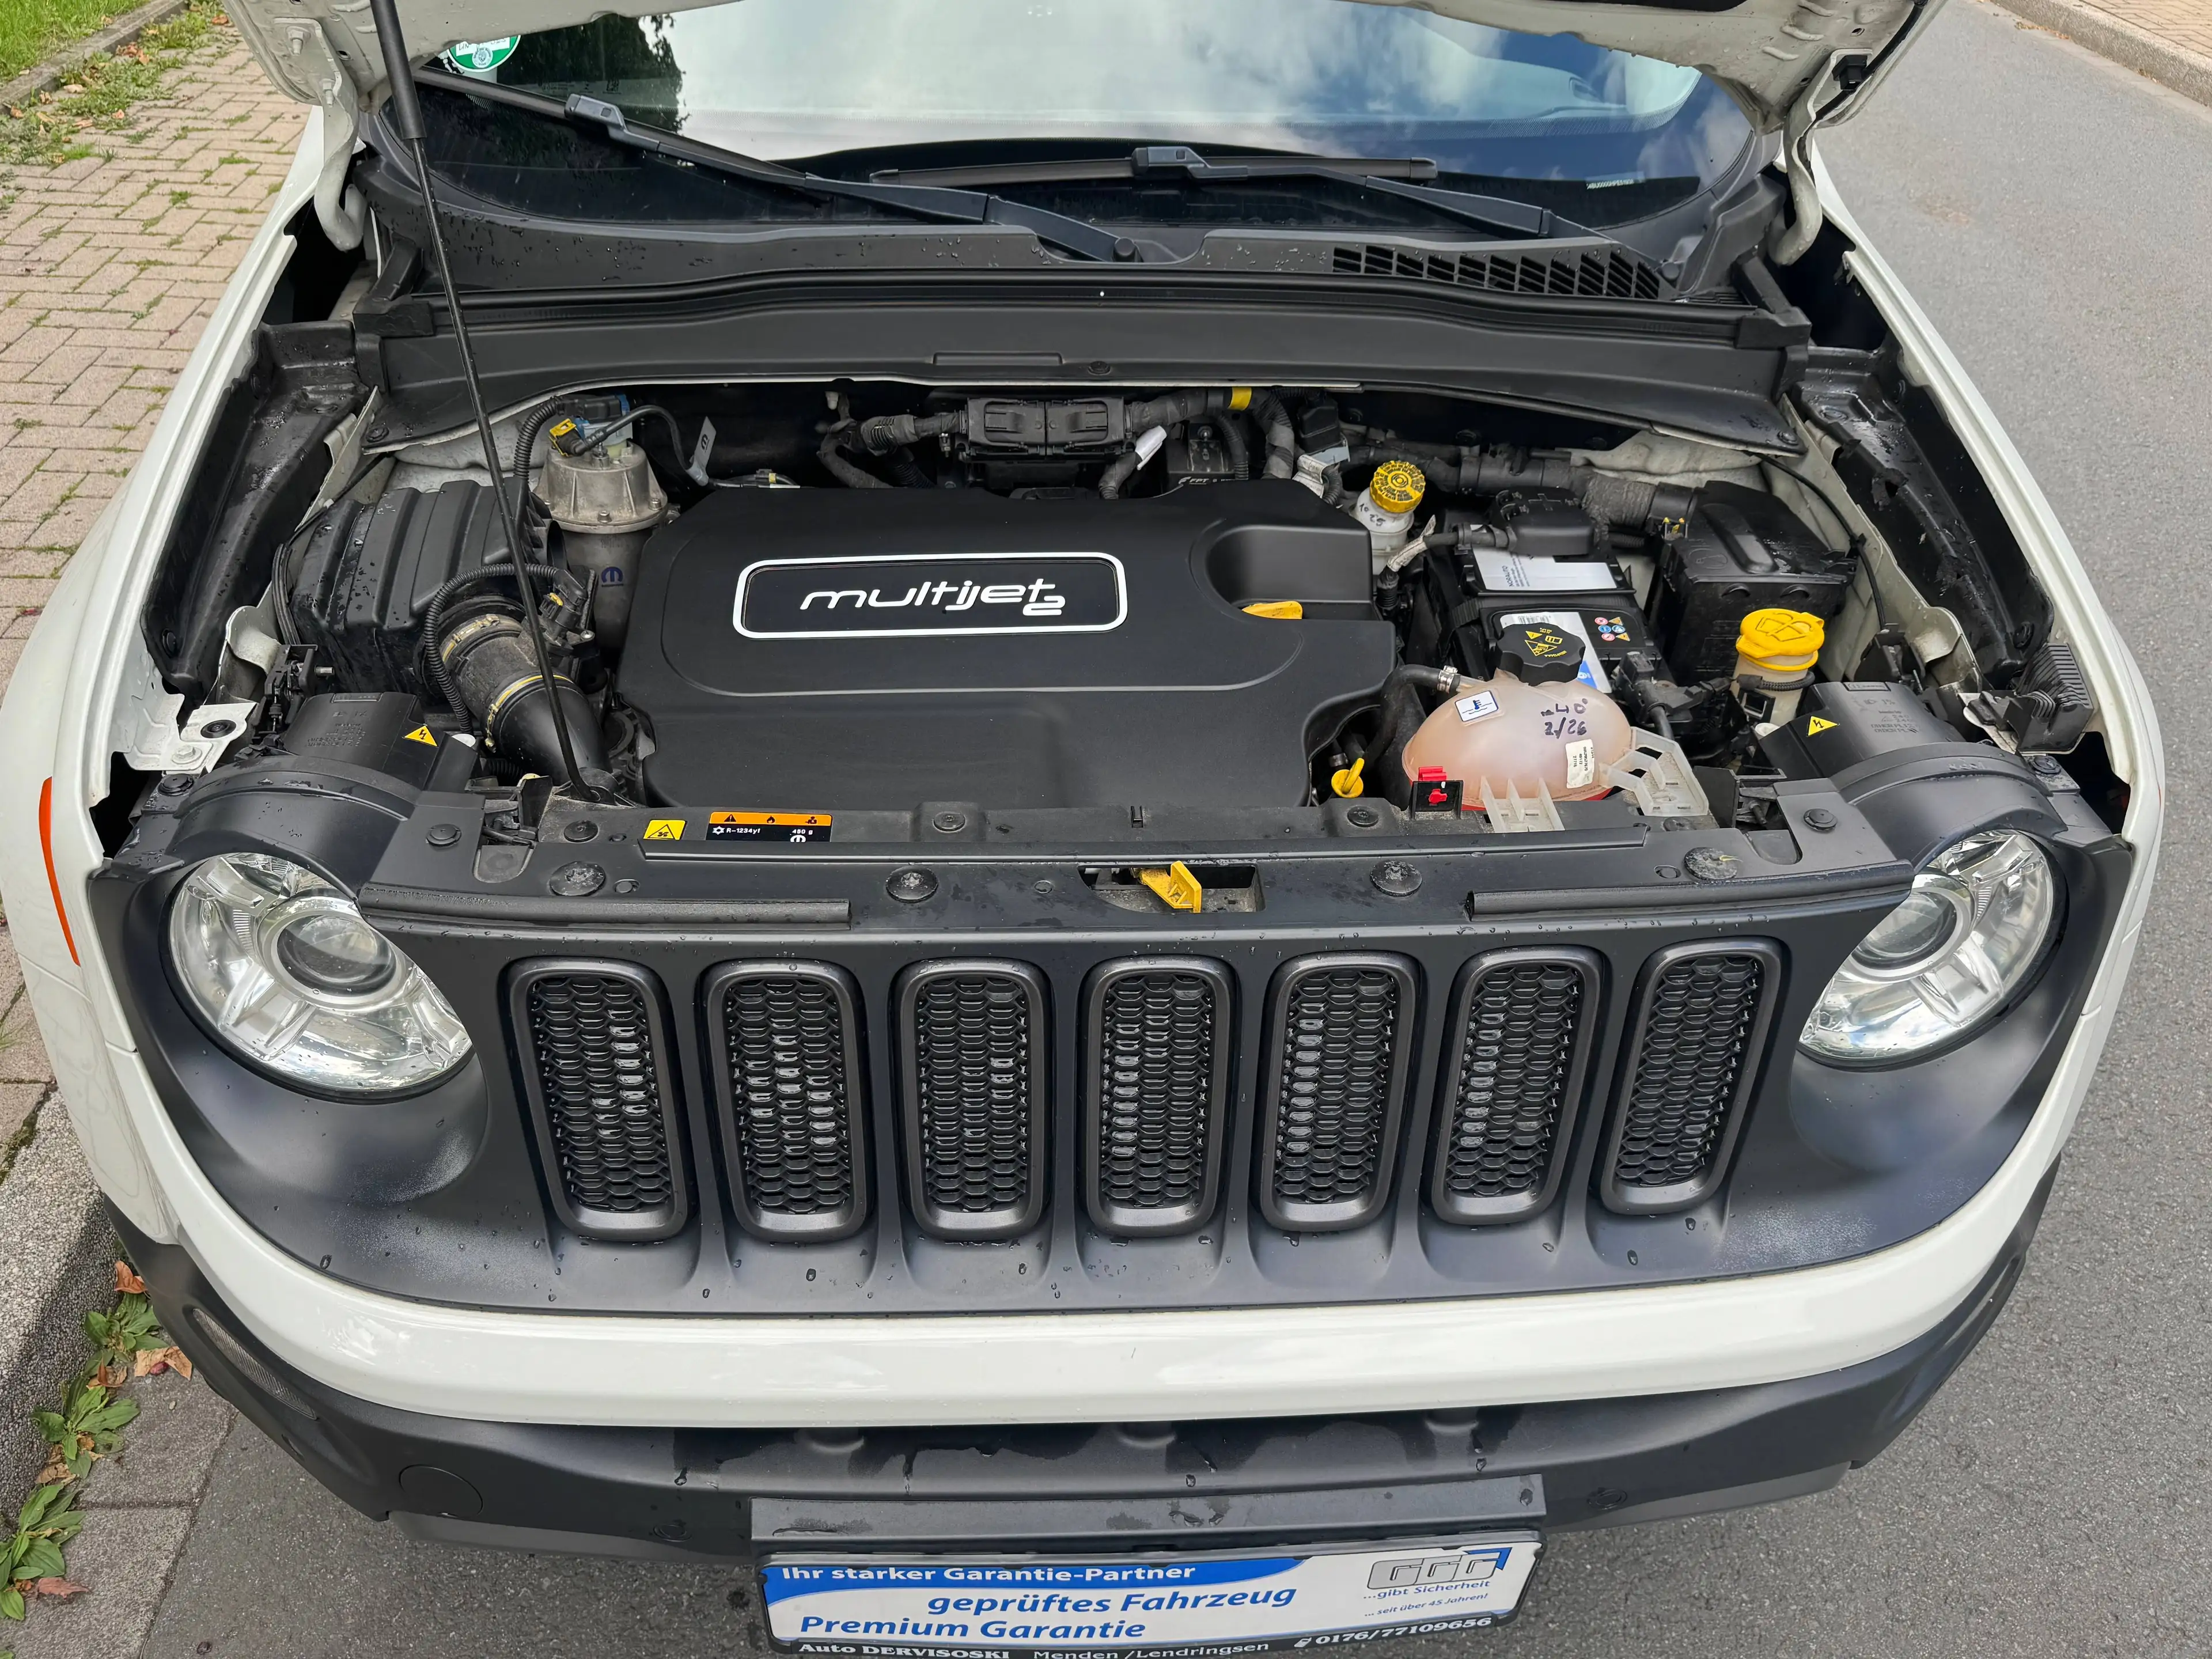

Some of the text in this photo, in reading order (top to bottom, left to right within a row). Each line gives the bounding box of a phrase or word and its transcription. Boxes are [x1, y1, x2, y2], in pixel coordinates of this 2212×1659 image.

[800, 578, 1056, 611] multijet
[782, 1566, 1196, 1581] Ihr starker Garantie-Partner
[1413, 1580, 1491, 1594] Sicherheit
[927, 1588, 1297, 1616] geprüftes Fahrzeug
[1377, 1606, 1401, 1615] seit
[1400, 1601, 1427, 1612] über
[1427, 1599, 1443, 1607] 45
[1444, 1592, 1488, 1605] Jahren!
[798, 1643, 857, 1654] Auto
[861, 1646, 1010, 1659] DERVISOSKI
[1033, 1650, 1119, 1659] Menden
[1315, 1617, 1492, 1645] 0176/77109656
[800, 1616, 1146, 1639] Premium Garantie
